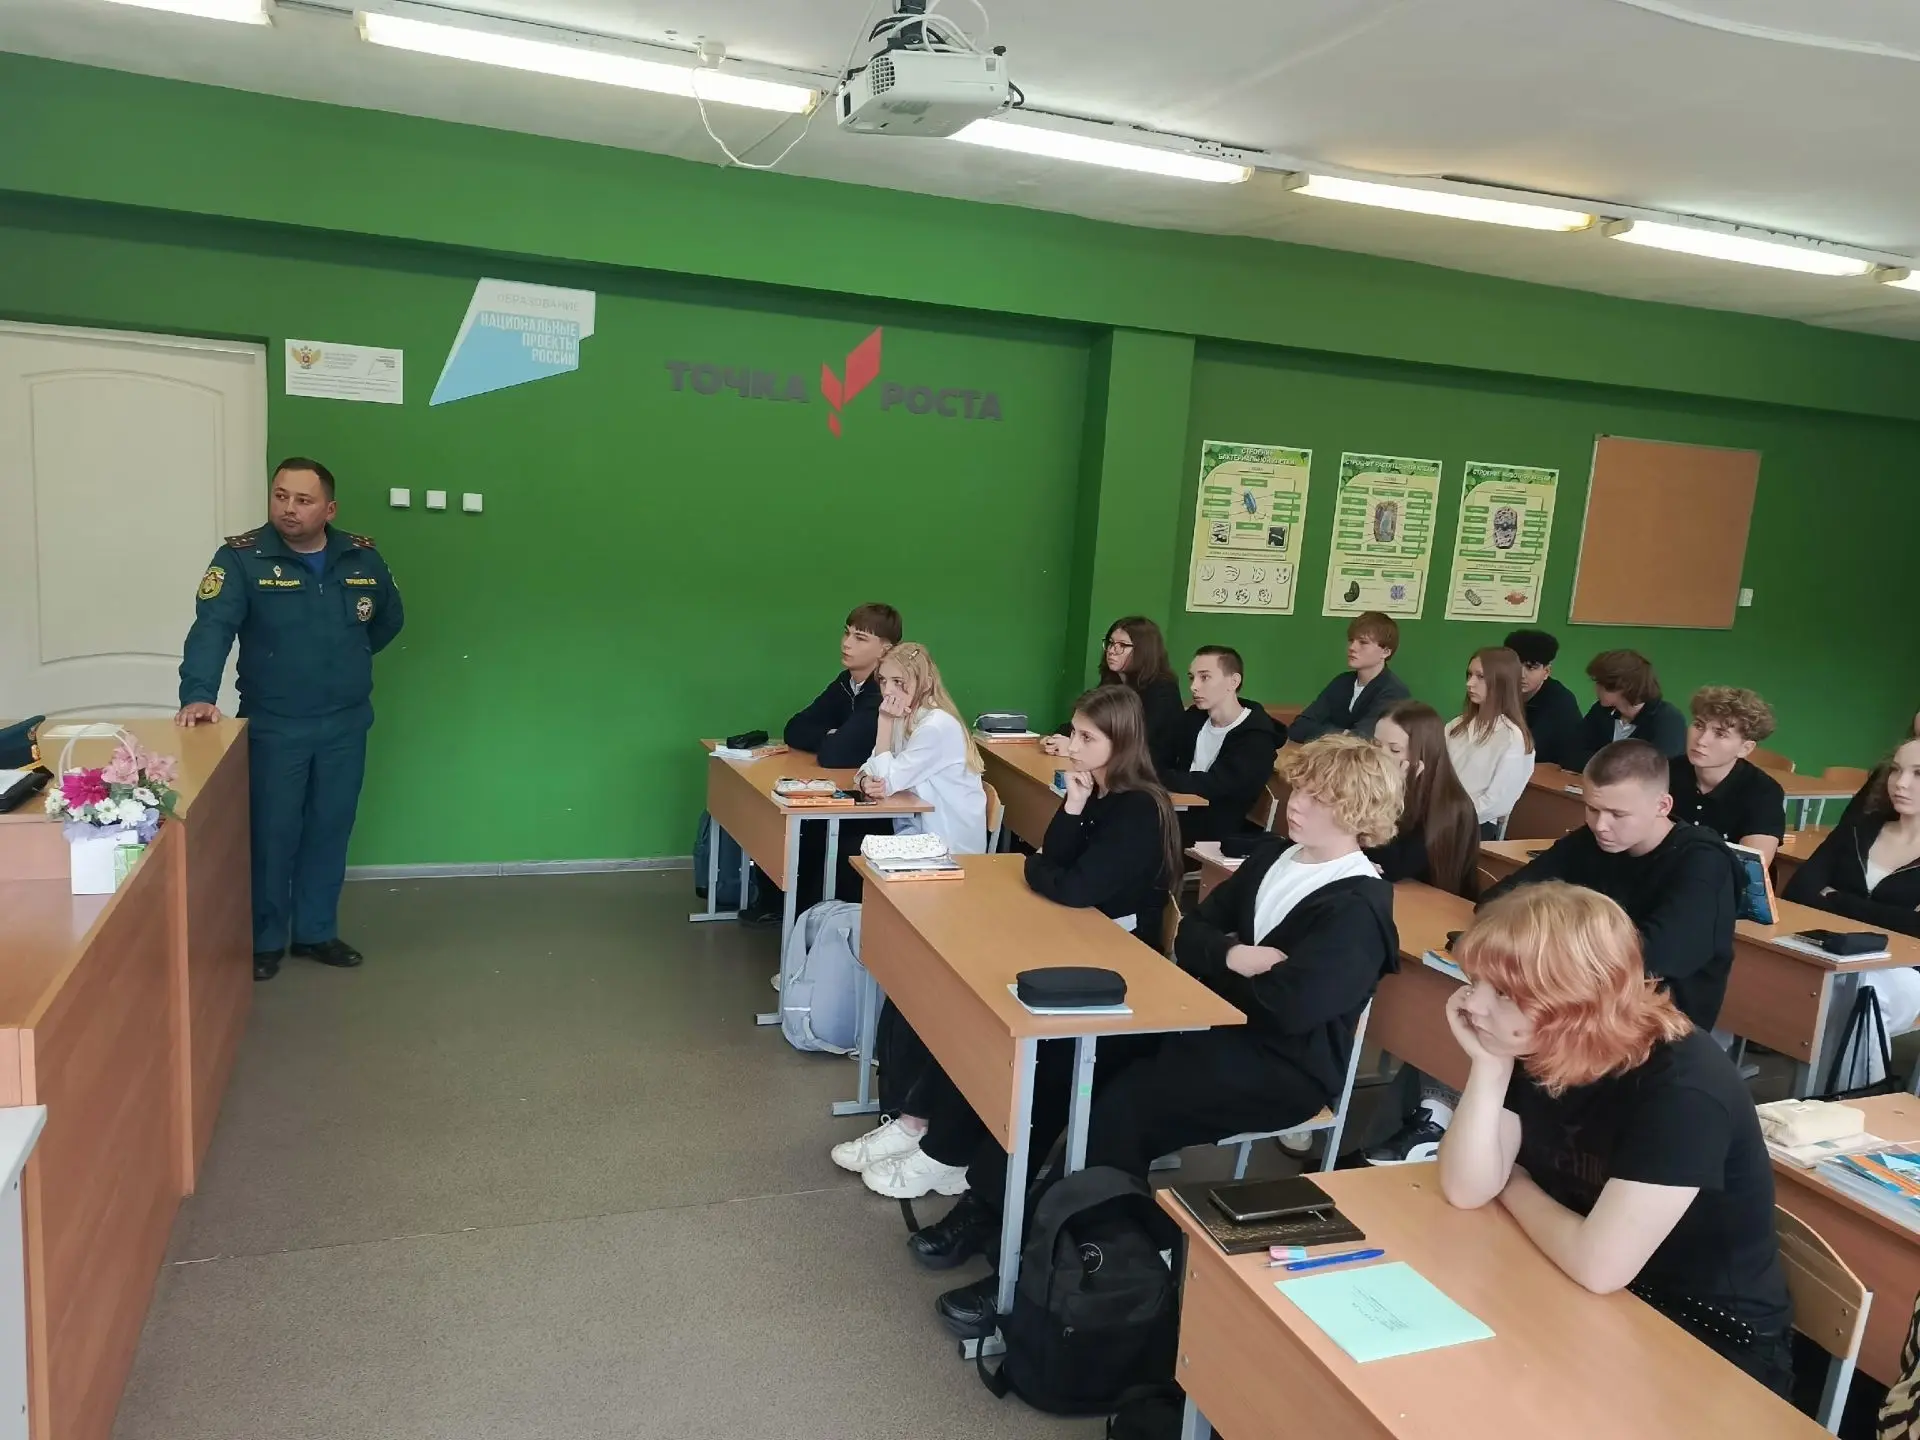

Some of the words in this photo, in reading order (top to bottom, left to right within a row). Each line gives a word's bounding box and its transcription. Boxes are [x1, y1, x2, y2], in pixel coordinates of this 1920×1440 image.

[497, 293, 580, 311] ОБРАЗОВАНИЕ
[481, 313, 578, 337] НАЦИОНАЛЬНЫЕ
[522, 332, 577, 351] ПРОЕКТЫ
[532, 348, 576, 366] РОССИИ
[665, 360, 810, 403] ТОЧКА
[880, 381, 1004, 422] РОСТА
